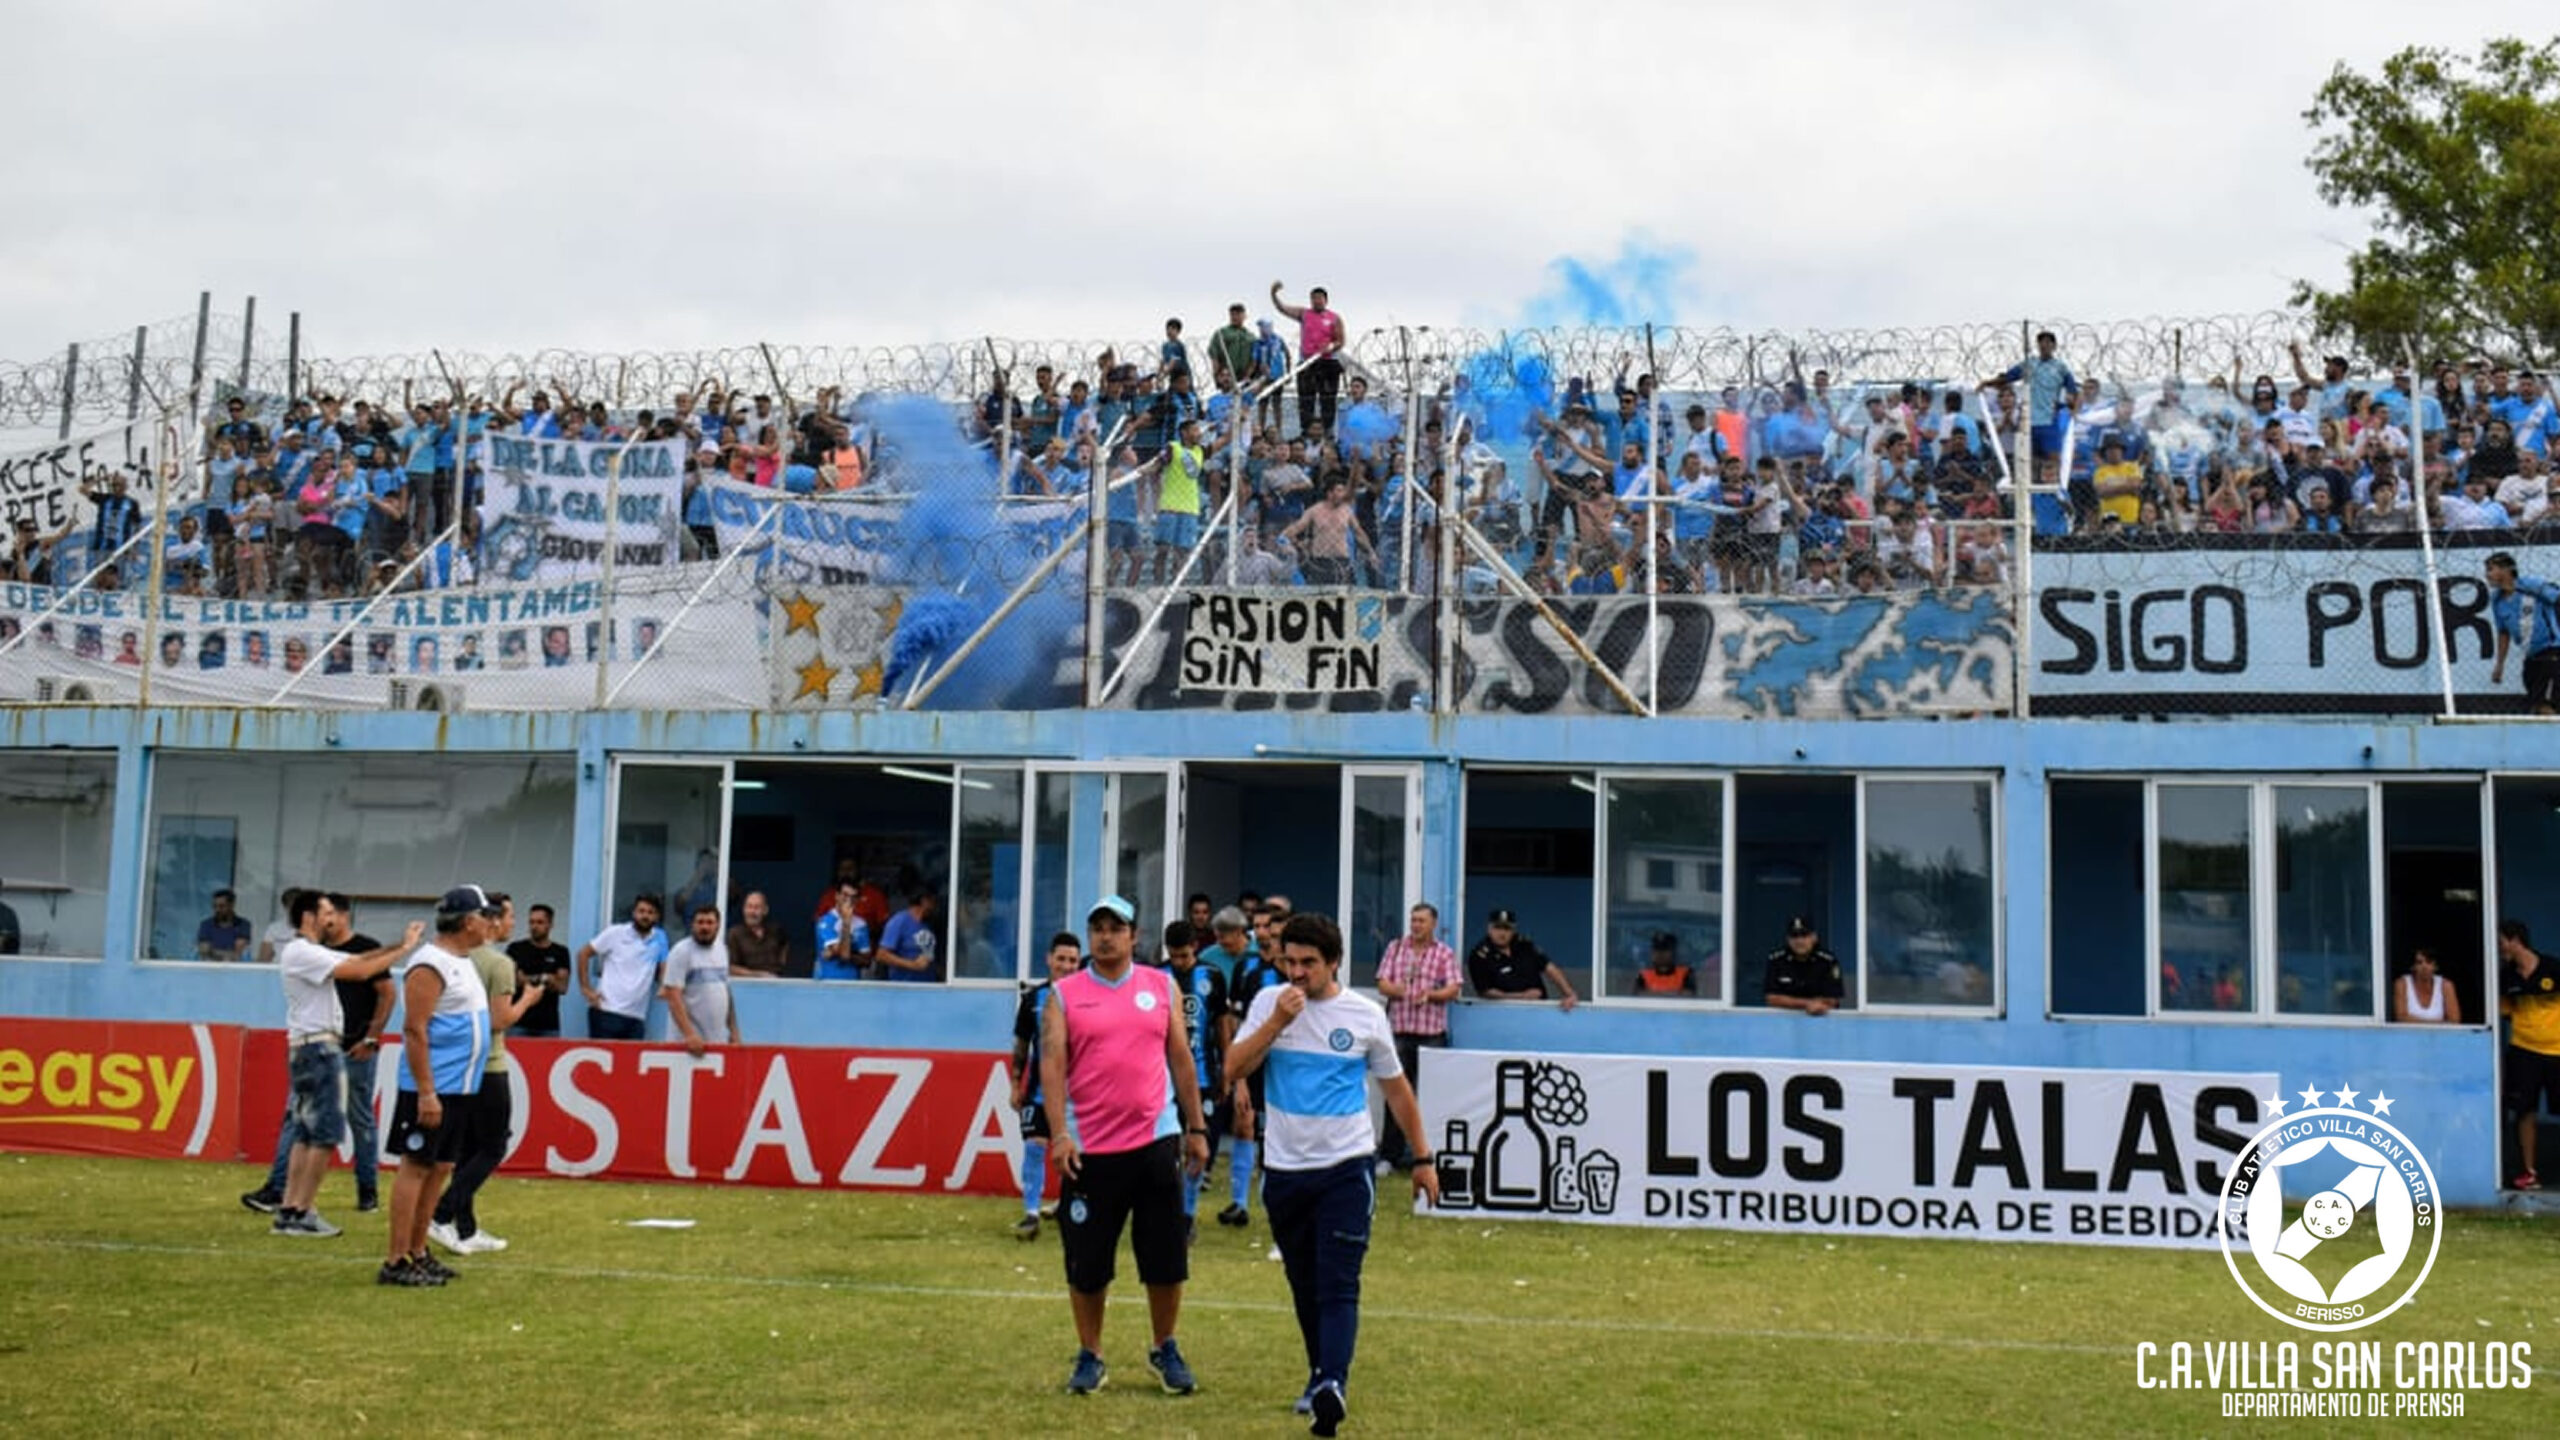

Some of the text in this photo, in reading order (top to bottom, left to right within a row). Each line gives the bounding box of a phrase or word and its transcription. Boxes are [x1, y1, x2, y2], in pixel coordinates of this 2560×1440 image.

[541, 443, 586, 477] LA
[562, 491, 662, 525] CAON
[541, 534, 664, 566] GIOVNNI
[2307, 576, 2495, 669] POR
[0, 1050, 196, 1131] easy
[336, 1043, 1038, 1190] STAZA
[1647, 1070, 2258, 1197] LOS TALAS
[1645, 1188, 1980, 1230] DISTRIBUIDORA
[1997, 1202, 2053, 1232] DE
